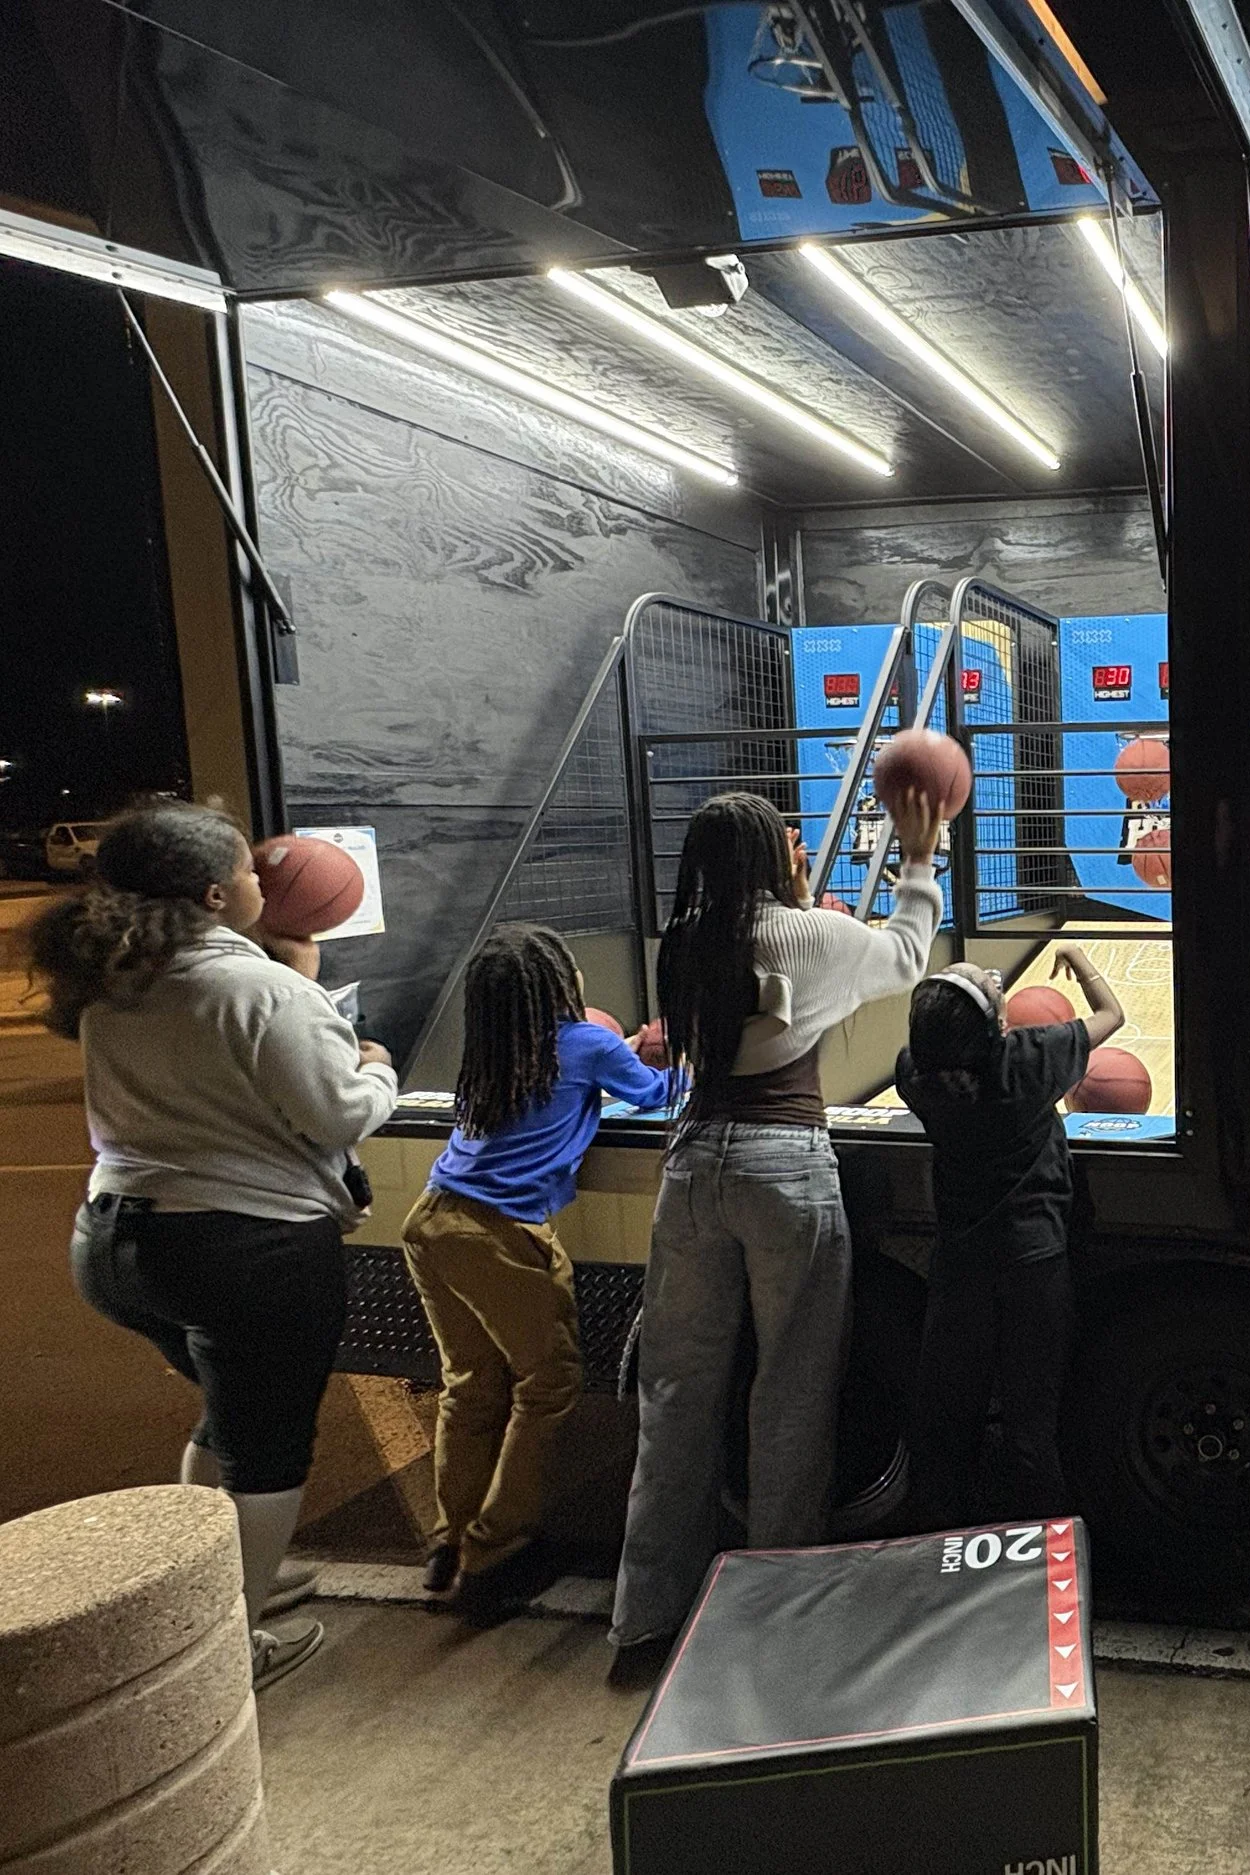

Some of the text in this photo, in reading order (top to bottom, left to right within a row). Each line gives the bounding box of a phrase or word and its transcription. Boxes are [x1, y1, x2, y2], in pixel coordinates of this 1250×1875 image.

[1094, 689, 1130, 699] HIGHEST
[826, 696, 859, 706] HIGHEST
[940, 1526, 1044, 1574] 20 INCH
